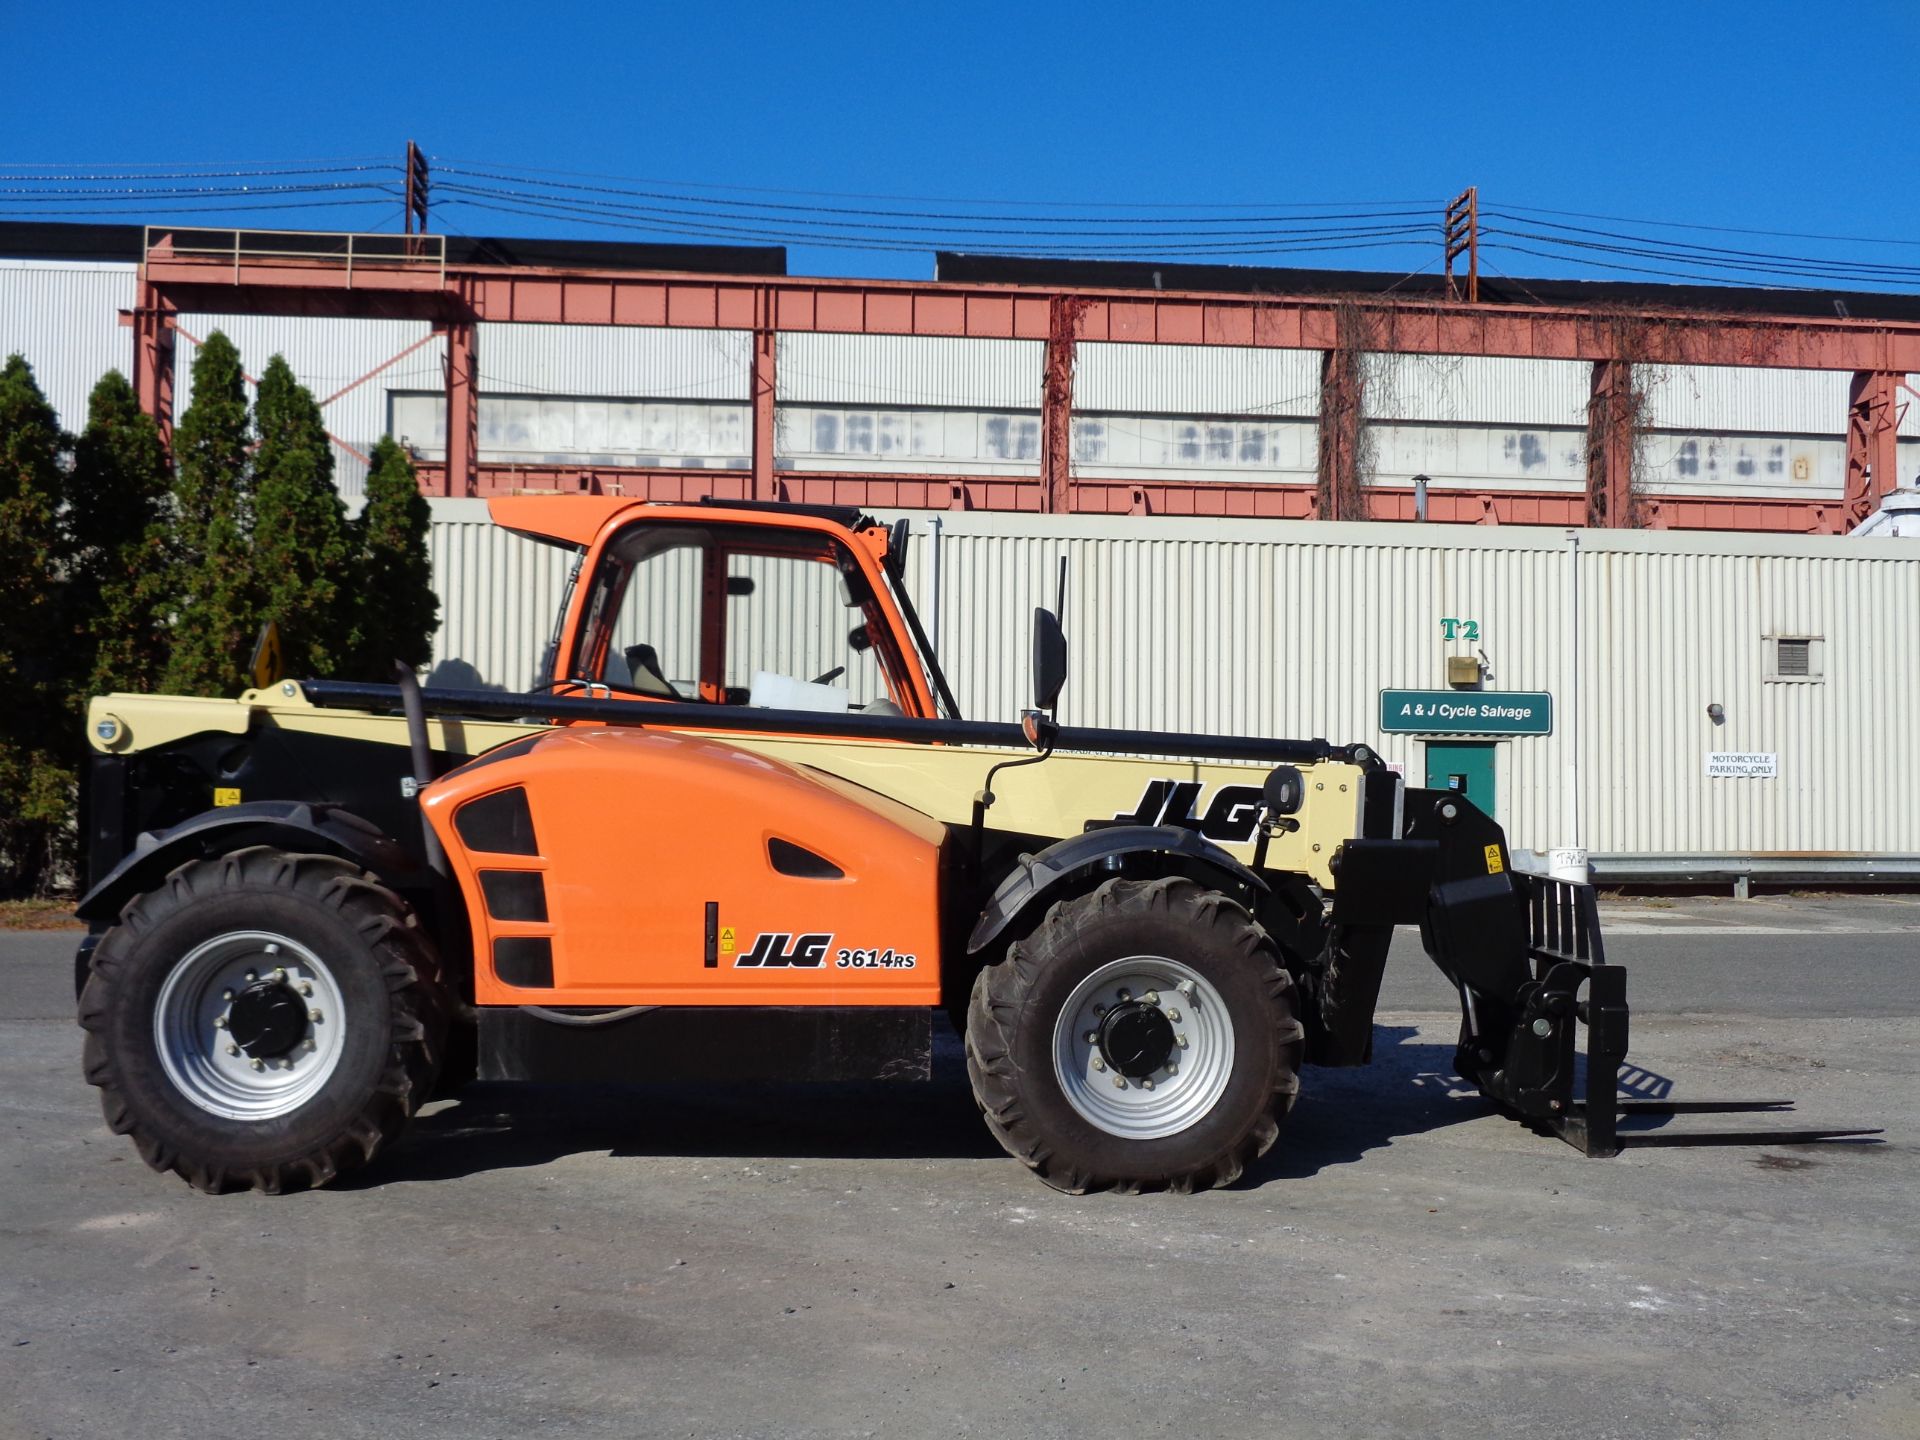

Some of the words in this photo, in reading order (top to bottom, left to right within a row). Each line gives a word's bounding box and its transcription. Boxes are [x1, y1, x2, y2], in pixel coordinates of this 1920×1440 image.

[1440, 618, 1479, 640] T2
[1400, 704, 1411, 716] A
[1414, 704, 1425, 716] &
[1427, 704, 1436, 717] J
[1439, 704, 1477, 719] Cycle
[1480, 704, 1532, 720] Salvage
[1711, 755, 1770, 764] MOTORCYCLE
[1388, 763, 1403, 773] RING
[1709, 765, 1748, 774] PARKING
[1750, 765, 1774, 774] ONLY
[1114, 779, 1266, 843] JLG
[734, 933, 834, 968] JLG
[836, 949, 916, 968] 3614RS
